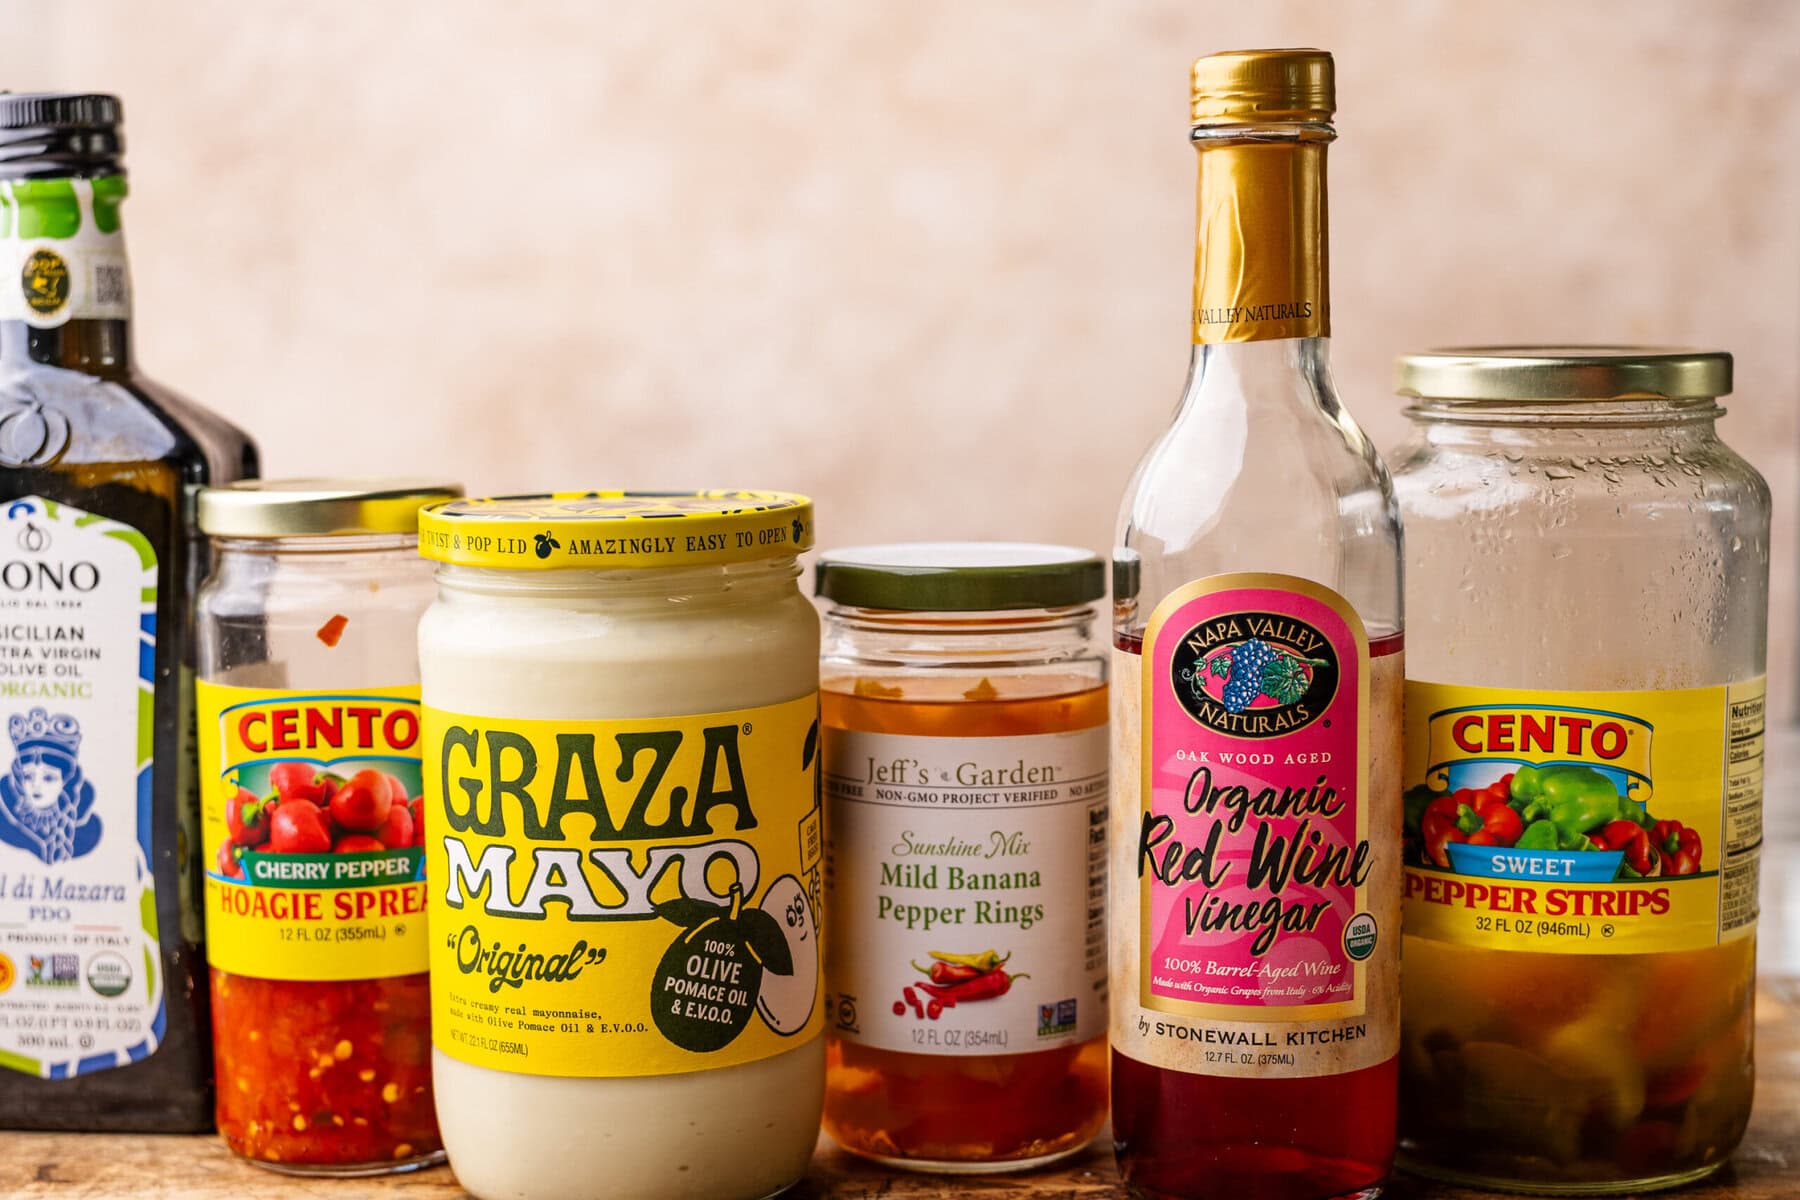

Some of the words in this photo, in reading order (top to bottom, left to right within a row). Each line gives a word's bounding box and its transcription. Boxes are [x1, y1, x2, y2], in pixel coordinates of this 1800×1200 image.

[1199, 307, 1242, 324] VALLEY
[1245, 302, 1312, 322] NATURALS
[467, 535, 492, 552] POP
[497, 537, 527, 554] LID
[568, 536, 676, 555] AMAZINGLY
[686, 533, 727, 552] EASY
[736, 531, 753, 548] TO
[759, 526, 787, 545] OPEN
[0, 625, 85, 641] ICILIAN
[1187, 618, 1243, 655] NAPA
[1247, 617, 1324, 652] VALLEY
[41, 647, 101, 660] VIRGIN
[54, 663, 83, 677] OIL
[238, 706, 420, 753] CENTO
[1199, 702, 1310, 734] NATURALS
[1452, 713, 1628, 760] CENTO
[1176, 749, 1209, 762] OAK
[1219, 752, 1274, 765] WOOD
[1284, 752, 1332, 765] AGED
[442, 724, 758, 841] GRAZA
[956, 760, 1055, 787] Garden
[876, 788, 938, 803] NON-GMO
[942, 792, 999, 805] PROJECT
[1004, 789, 1058, 802] VERIFIED
[1184, 767, 1345, 834] Organic
[891, 830, 982, 857] Sunshine
[984, 830, 1031, 859] Mix
[1138, 811, 1231, 888] Red
[1246, 819, 1375, 894] Wine
[255, 860, 330, 880] CHERRY
[335, 857, 411, 879] PEPPER
[443, 836, 760, 921] MAYO
[880, 862, 937, 889] Mild
[947, 866, 1041, 891] Banana
[1491, 855, 1576, 877] SWEET
[13, 875, 33, 899] di
[42, 876, 127, 901] Mazara
[1404, 872, 1542, 915] PEPPER
[1545, 887, 1670, 917] STRIPS
[29, 906, 71, 922] PDO
[221, 885, 323, 921] HOAGIE
[878, 895, 966, 930] Pepper
[975, 900, 1044, 930] Rings
[280, 928, 292, 940] 12
[297, 928, 311, 941] FL
[315, 929, 332, 942] OZ
[336, 926, 386, 943] (355mL)
[1185, 890, 1332, 956] Vinegar
[1352, 923, 1371, 936] USDA
[1475, 916, 1492, 932] 32
[1495, 918, 1510, 933] FL
[1515, 919, 1532, 935] OZ
[1536, 918, 1591, 938] (946mL)
[8, 934, 67, 945] PRODUCT
[74, 935, 89, 945] OF
[96, 935, 132, 946] ITALY
[704, 939, 735, 957] 100%
[686, 955, 743, 984] OLIVE
[1164, 957, 1201, 974] 100%
[1205, 960, 1303, 985] Barrel-Aged
[1304, 960, 1341, 976] Wine
[664, 976, 726, 1002] POMACE
[728, 989, 748, 1007] OIL
[1152, 975, 1173, 988] Made
[1174, 980, 1192, 991] with
[1193, 982, 1229, 997] Organic
[1230, 985, 1261, 999] Grapes
[1259, 986, 1284, 999] from
[1286, 984, 1306, 999] Italy
[470, 1001, 500, 1014] creamy
[505, 1006, 526, 1016] real
[532, 1009, 602, 1021] mayonnaise,
[671, 999, 681, 1015] &
[685, 1001, 733, 1025] E.V.O.O.
[487, 1016, 513, 1029] Olive
[518, 1021, 556, 1032] Pomace
[560, 1023, 579, 1033] Oil
[586, 1023, 595, 1033] &
[601, 1022, 649, 1033] E.V.O.O.
[1138, 1015, 1150, 1037] by
[1155, 1021, 1277, 1046] STONEWALL
[1286, 1023, 1367, 1046] KITCHEN
[911, 1028, 924, 1044] 12
[928, 1030, 941, 1045] FL
[944, 1030, 961, 1047] OZ
[965, 1030, 1009, 1048] (354mL)
[1205, 1051, 1222, 1063] 12.7
[1225, 1053, 1238, 1064] FL.
[1241, 1053, 1256, 1065] OZ.
[1258, 1053, 1295, 1066] (375ML)
